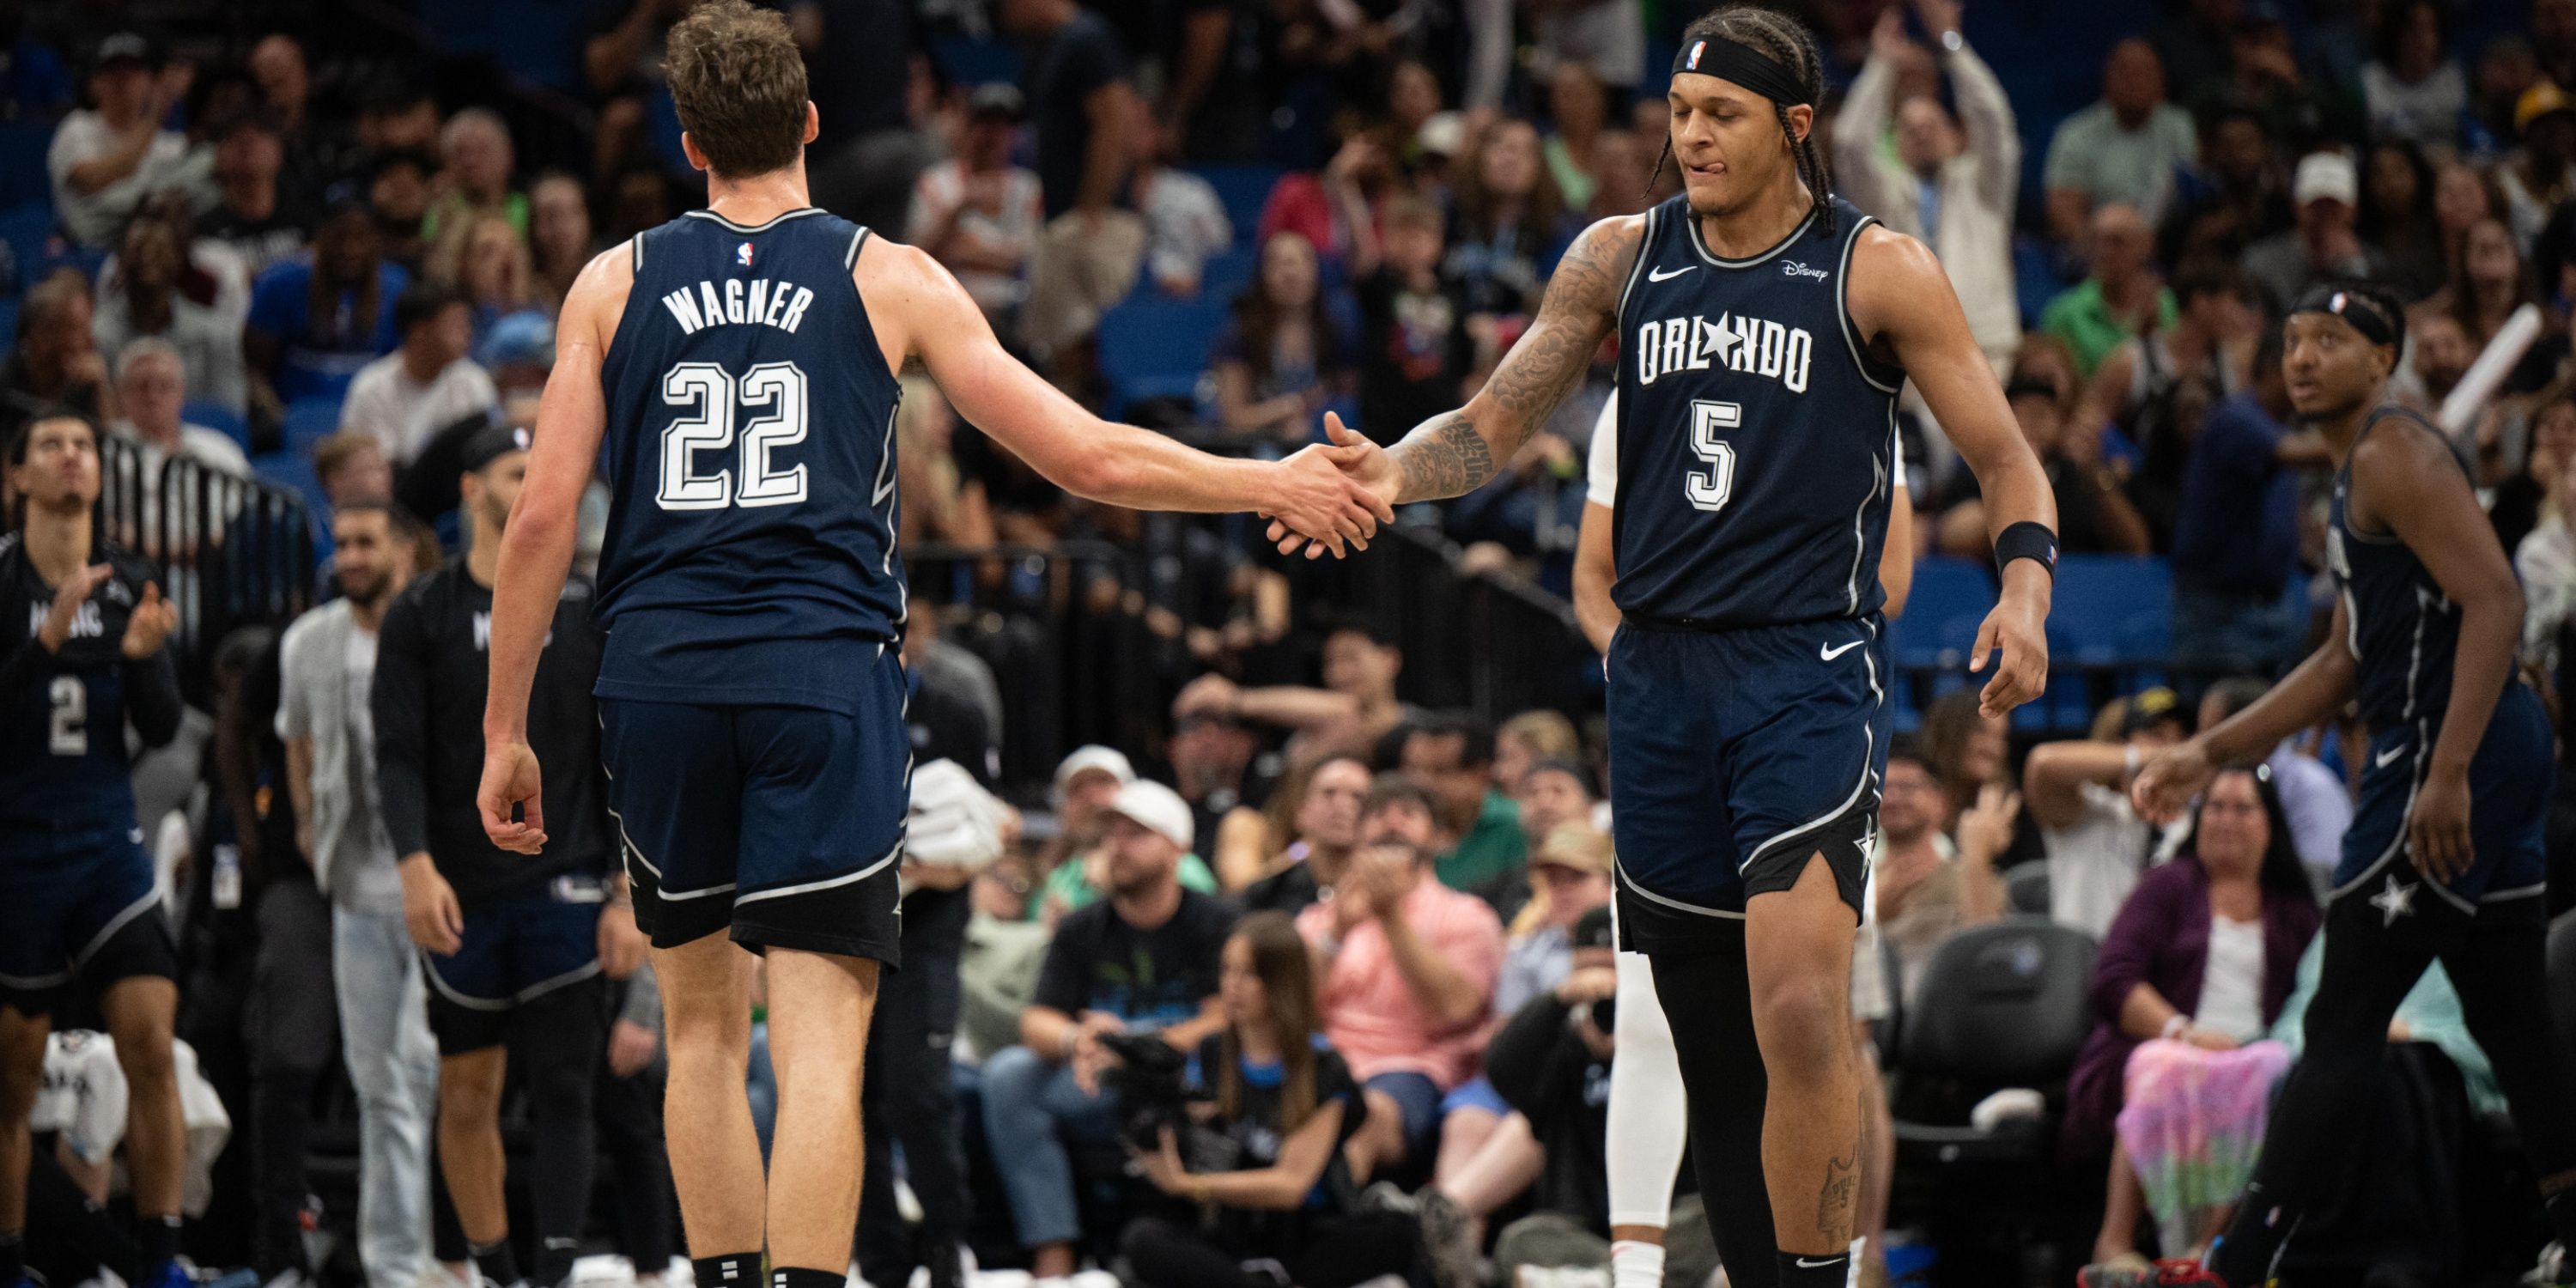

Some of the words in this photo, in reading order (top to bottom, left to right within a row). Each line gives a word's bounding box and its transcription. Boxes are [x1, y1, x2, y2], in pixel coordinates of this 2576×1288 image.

[661, 278, 814, 335] WAGNER
[1781, 259, 1829, 283] Disney
[655, 360, 808, 510] 22
[1685, 398, 1741, 511] 5
[49, 674, 87, 756] 2
